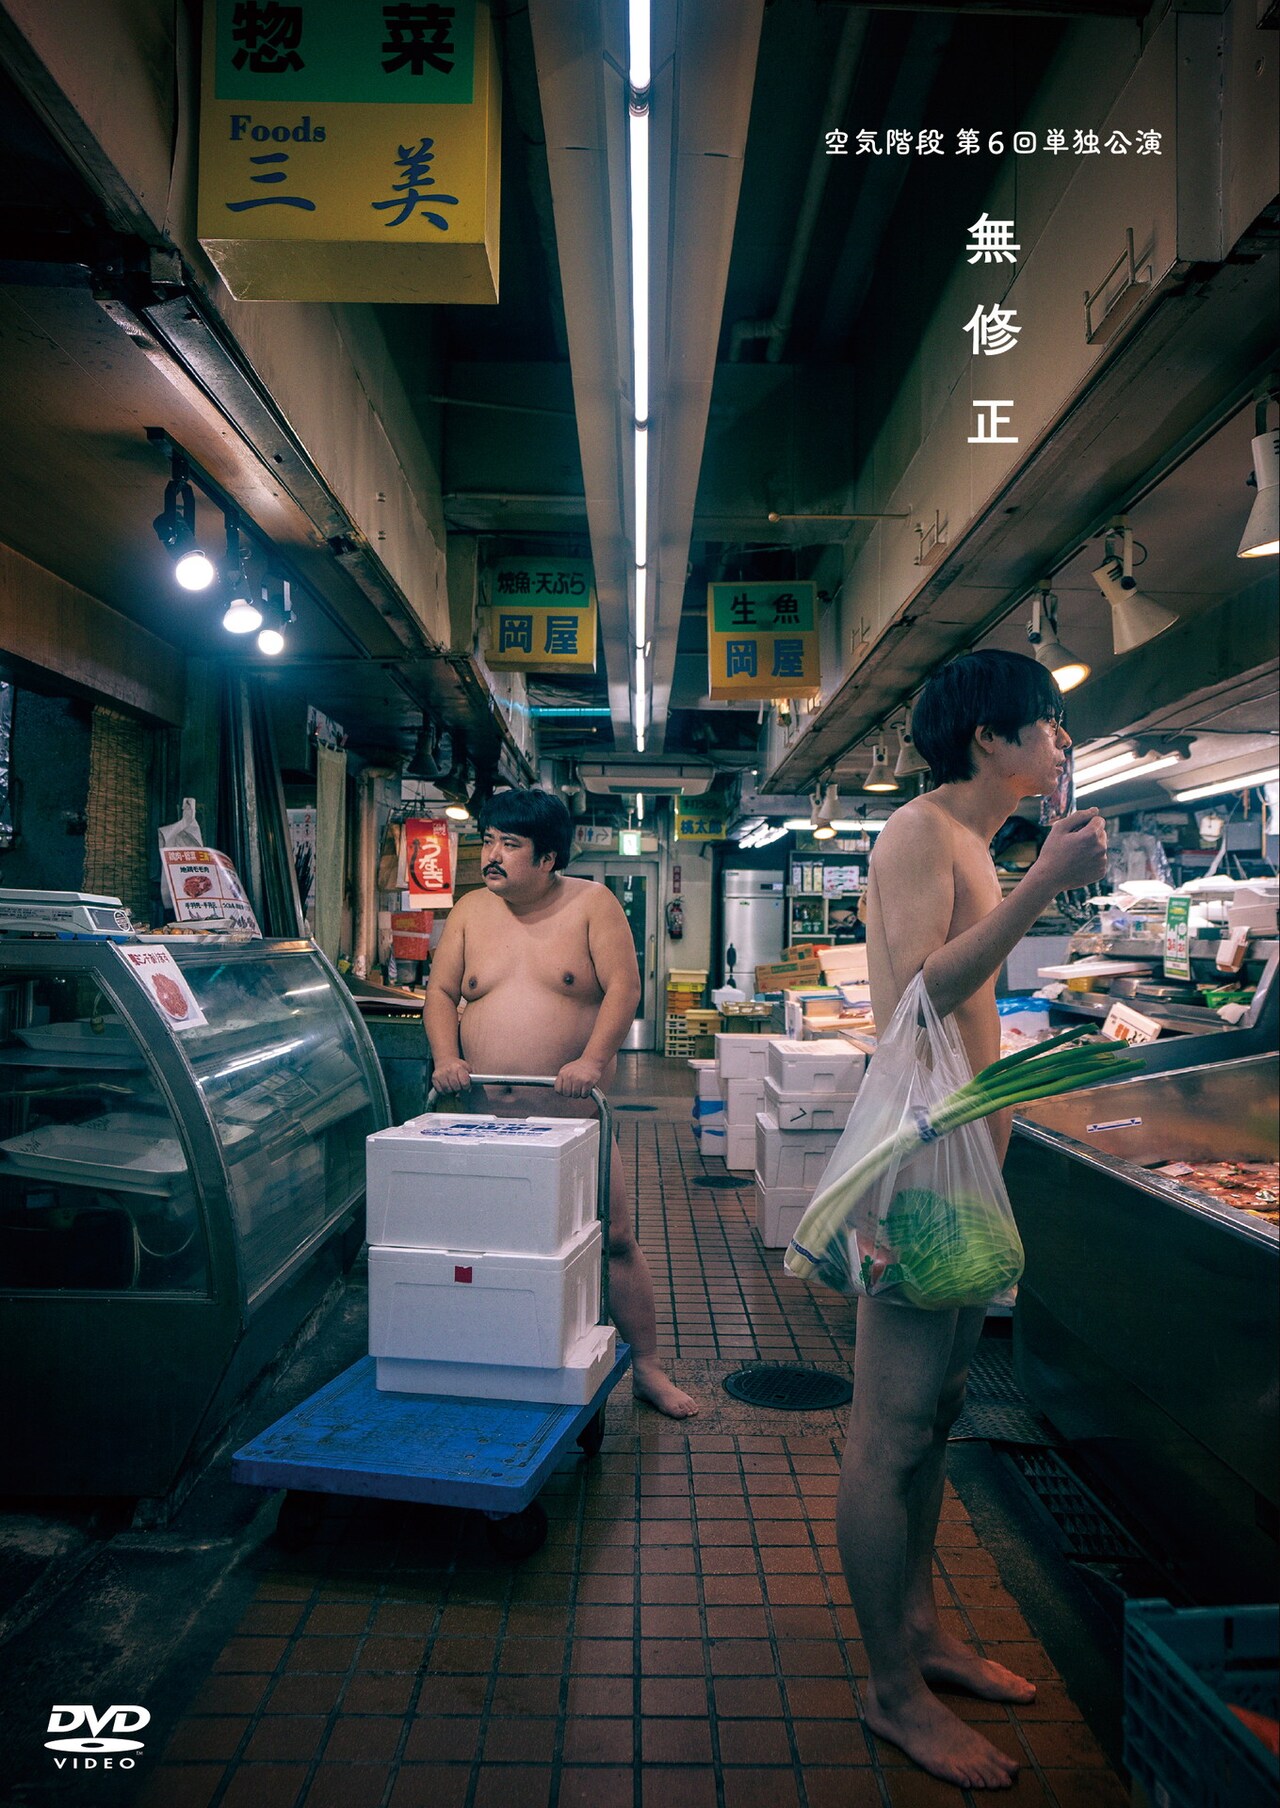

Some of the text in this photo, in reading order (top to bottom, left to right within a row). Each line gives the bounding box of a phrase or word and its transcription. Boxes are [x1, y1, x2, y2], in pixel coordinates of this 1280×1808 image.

[231, 1, 456, 75] 惣菜
[229, 115, 327, 143] Foods
[225, 137, 460, 231] 三美
[730, 593, 800, 625] 生魚
[498, 614, 579, 655] 岡屋
[726, 639, 804, 678] 岡屋
[417, 838, 444, 888] うなぎ
